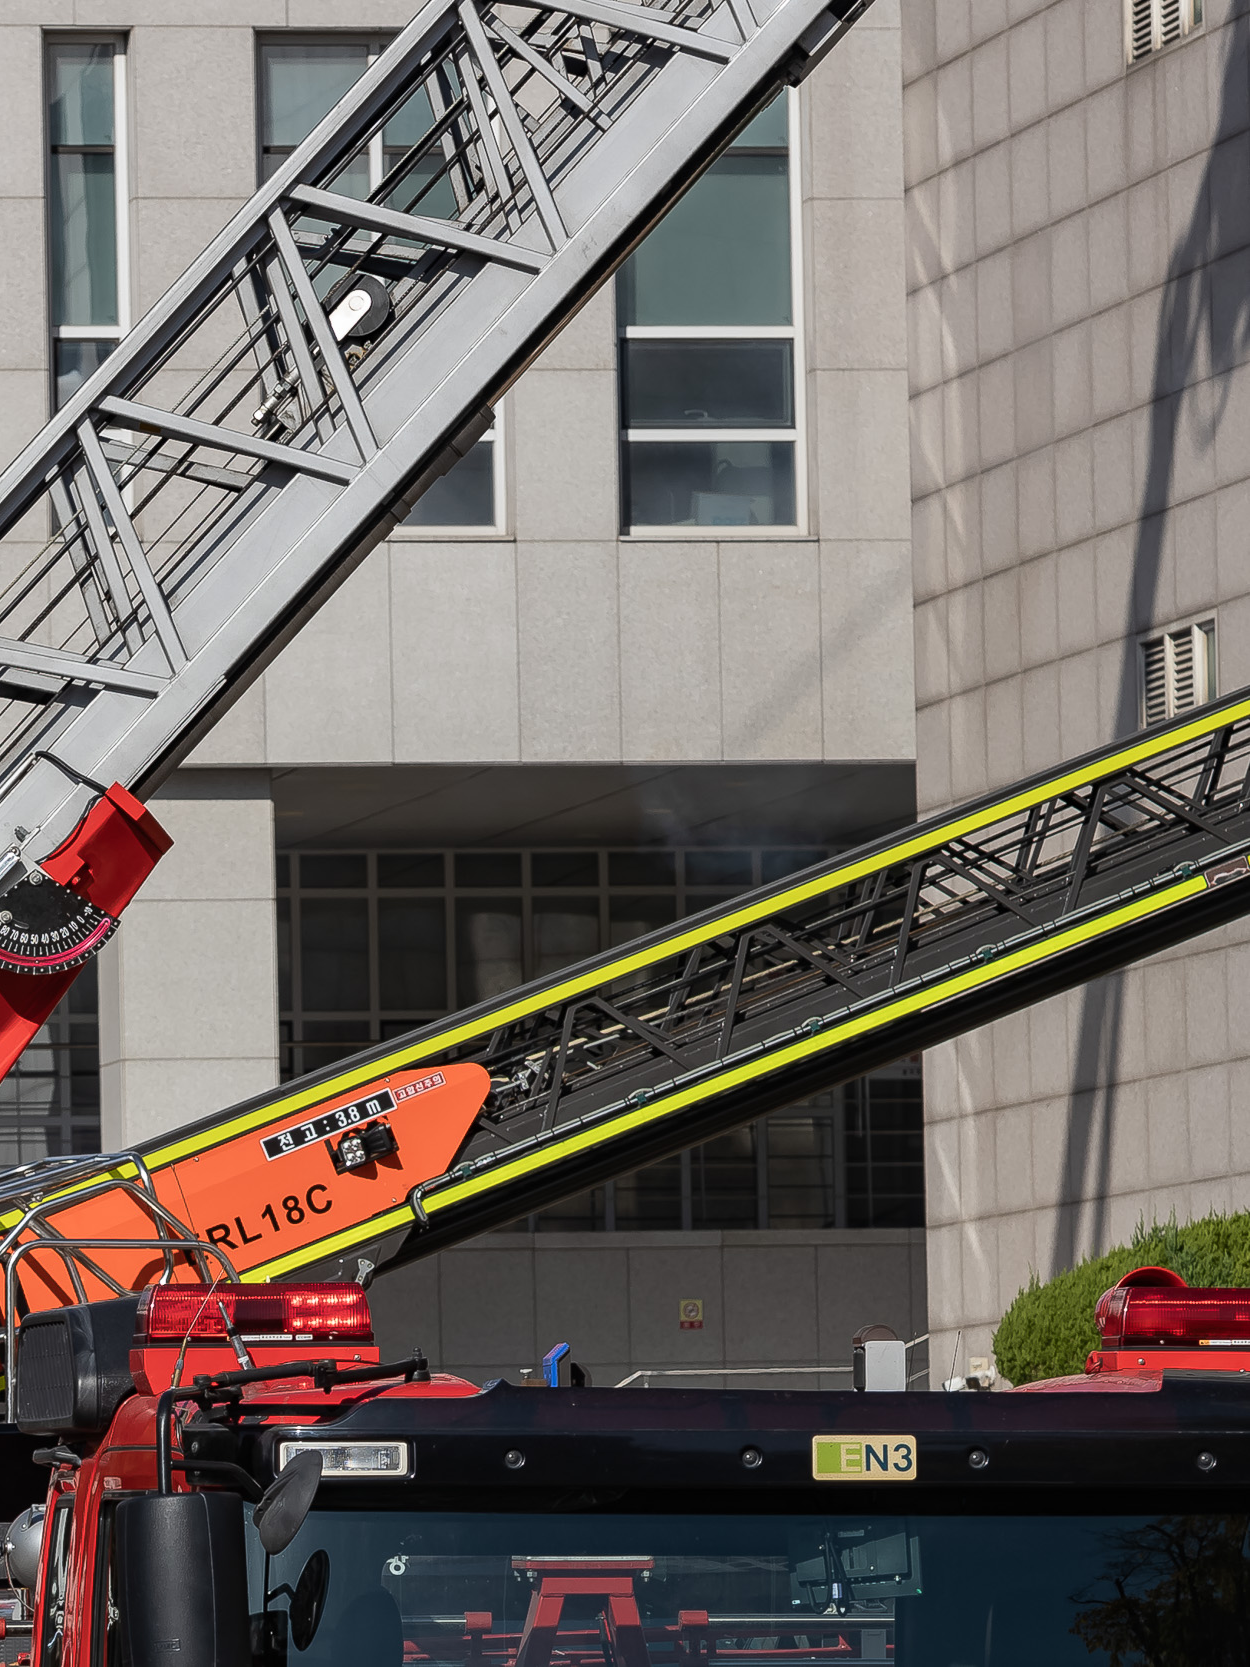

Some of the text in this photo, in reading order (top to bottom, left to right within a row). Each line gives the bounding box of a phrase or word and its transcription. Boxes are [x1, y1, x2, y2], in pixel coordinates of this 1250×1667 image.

[0, 925, 10, 936] 80
[10, 929, 19, 940] 70
[19, 932, 29, 944] 60
[30, 934, 39, 945] 50
[41, 933, 50, 944] 40
[50, 930, 60, 942] 30
[60, 926, 70, 938] 20
[68, 921, 79, 932] 10
[76, 915, 85, 924] 0
[277, 1132, 295, 1151] 전
[300, 1124, 318, 1142] 고
[335, 1106, 360, 1127] 3.8
[365, 1099, 382, 1116] m
[841, 1443, 913, 1472] EN3
